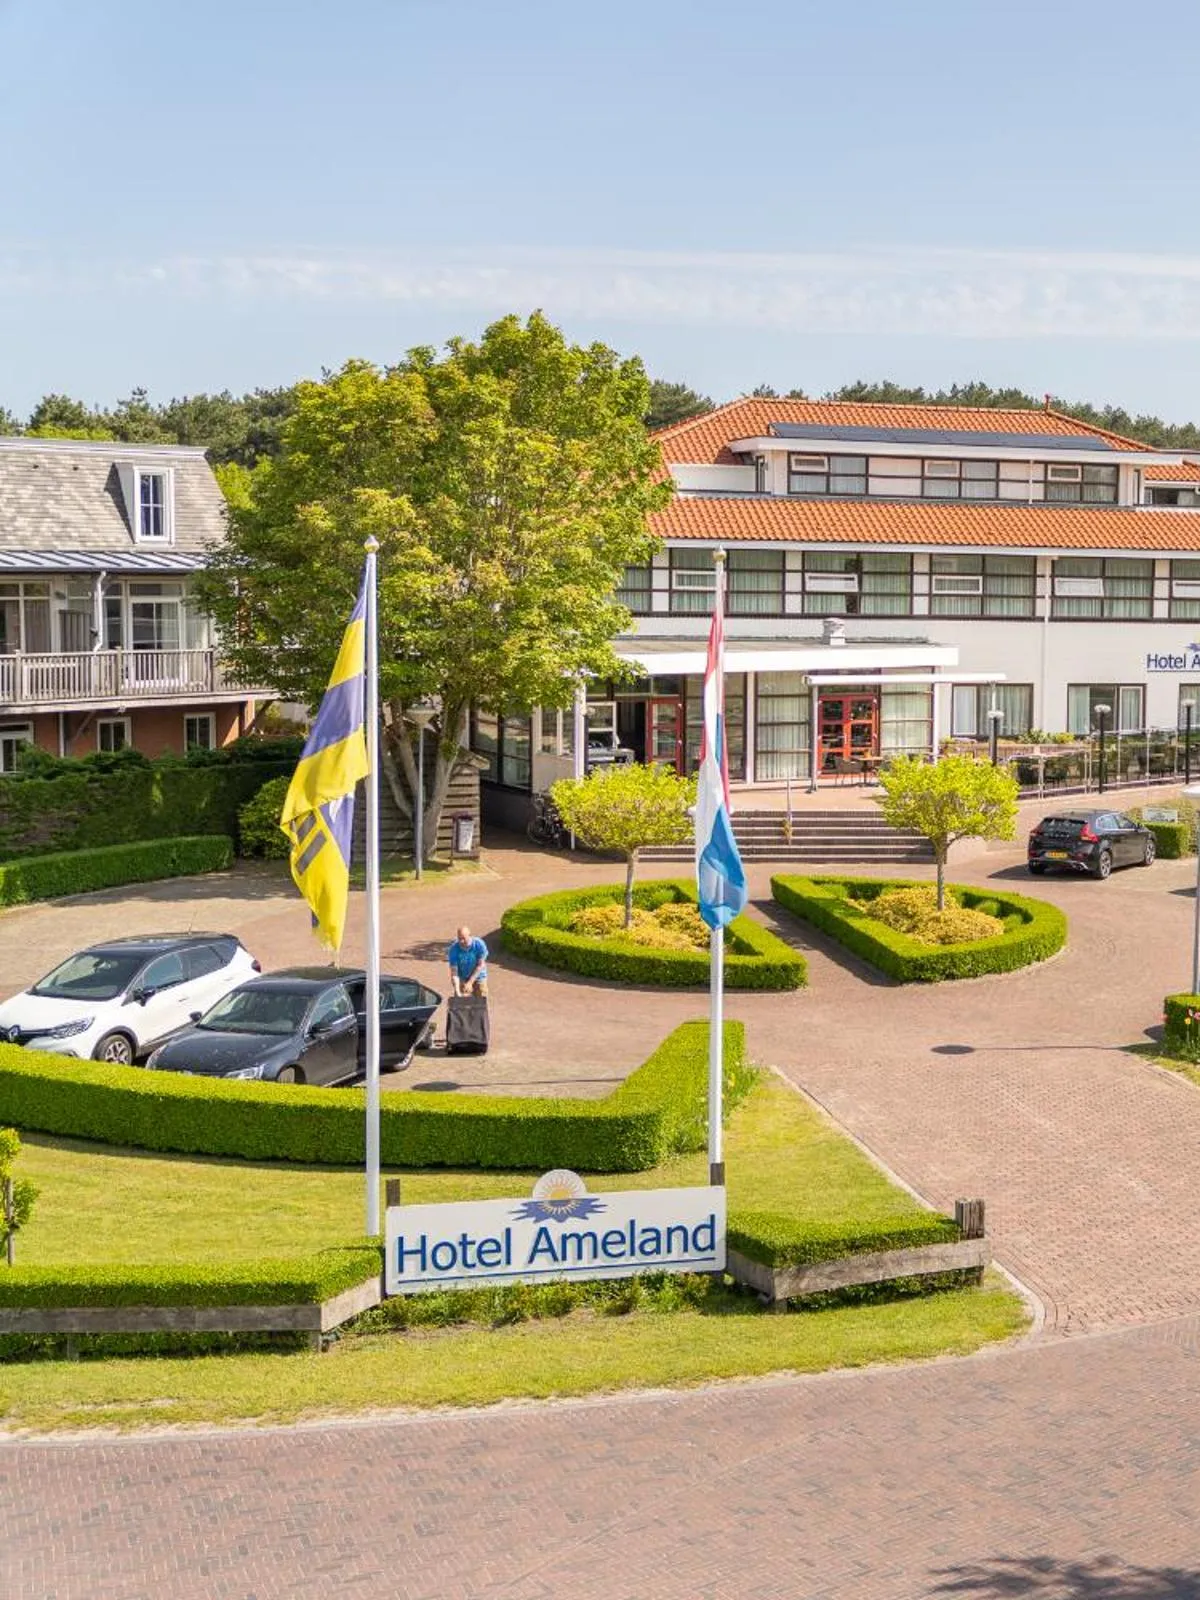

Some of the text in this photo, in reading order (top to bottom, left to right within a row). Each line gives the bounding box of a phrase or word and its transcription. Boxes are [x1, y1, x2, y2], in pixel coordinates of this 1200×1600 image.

[1146, 653, 1187, 669] Hotel
[396, 1214, 716, 1274] Hotel Ameland
